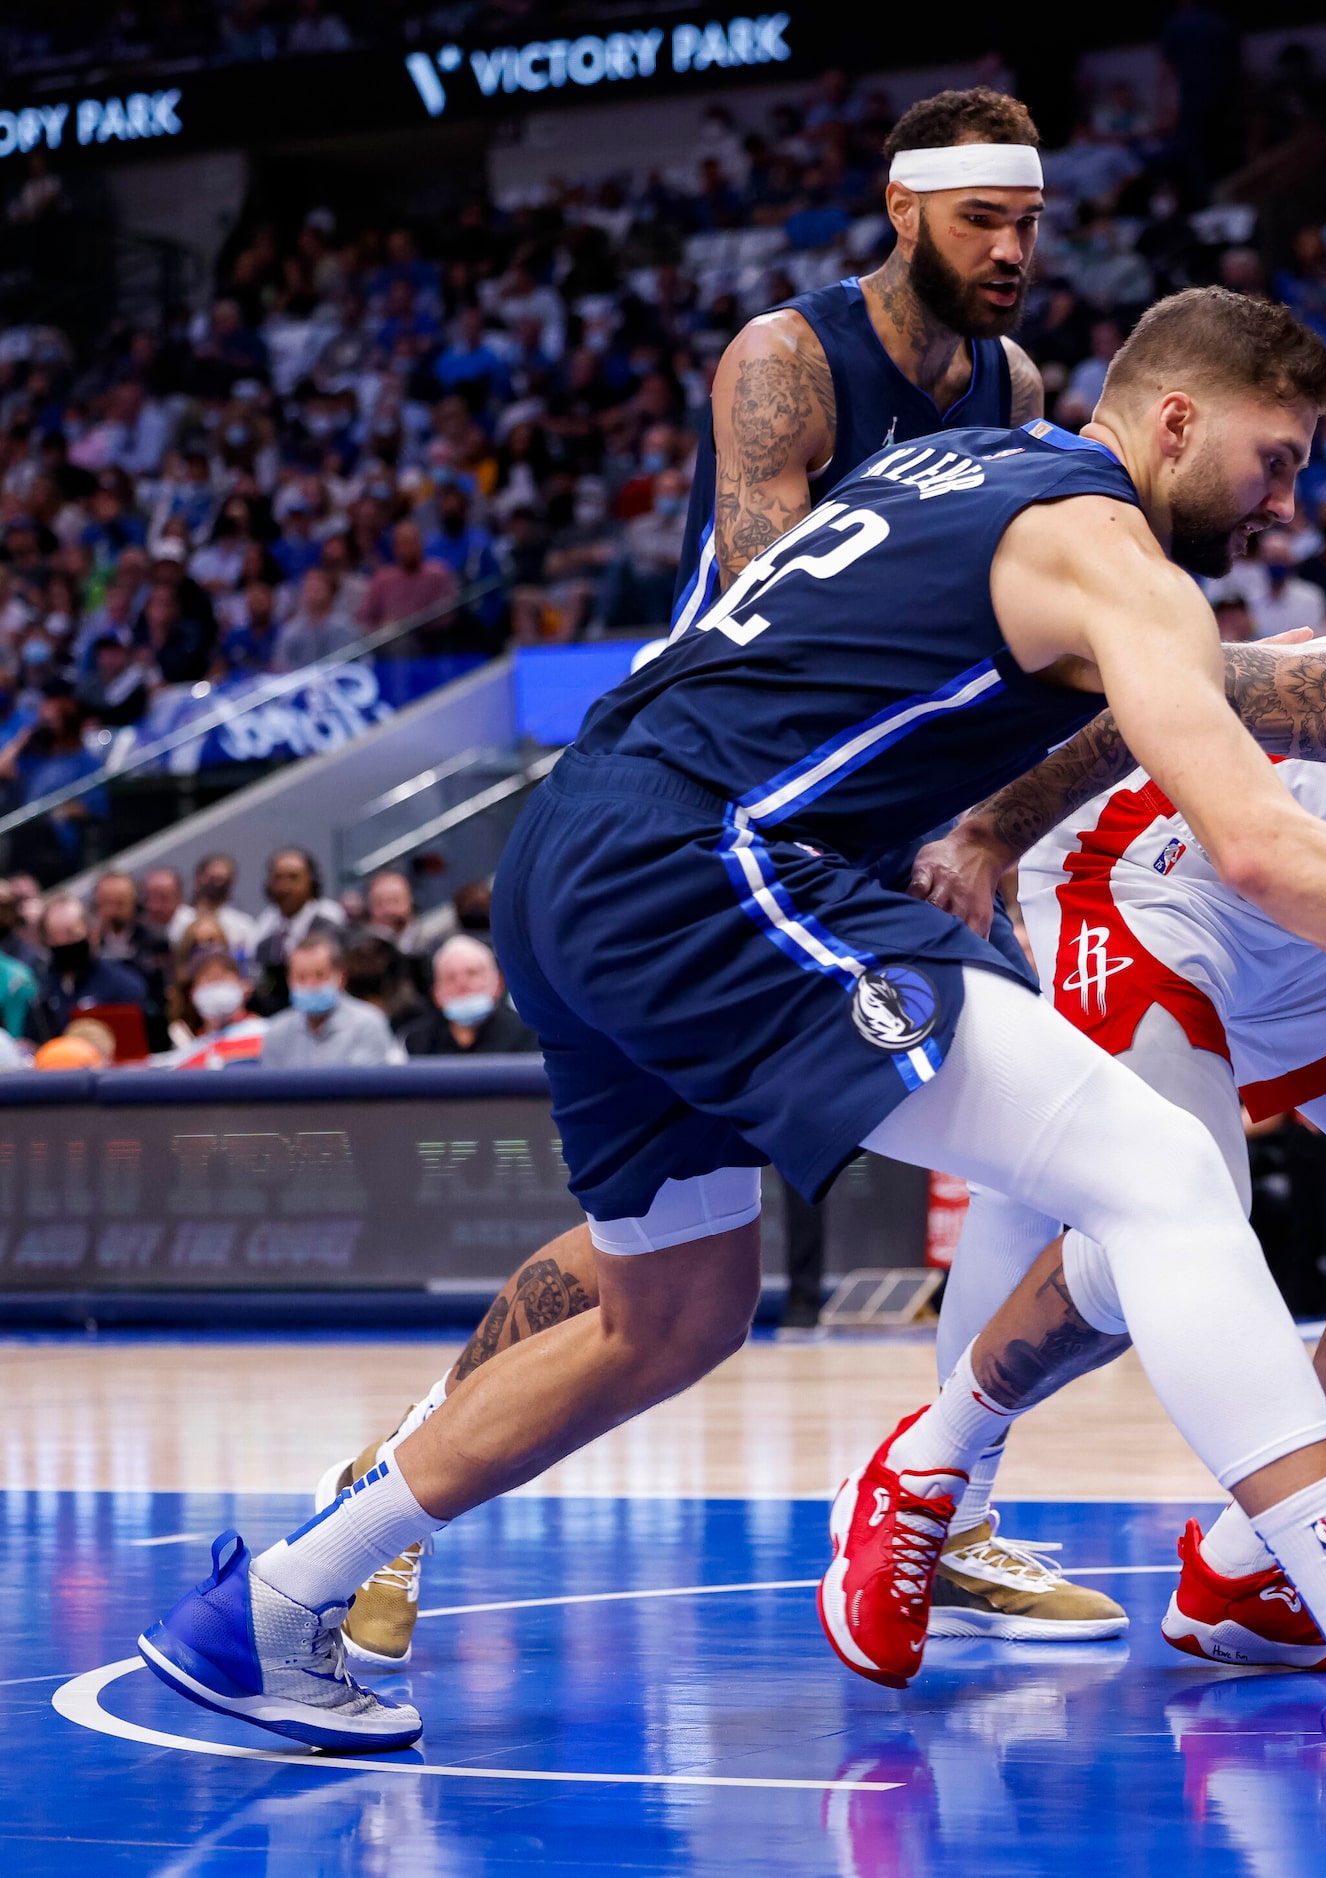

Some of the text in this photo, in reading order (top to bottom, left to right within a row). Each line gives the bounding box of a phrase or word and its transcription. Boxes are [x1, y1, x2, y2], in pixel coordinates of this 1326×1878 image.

[470, 12, 790, 96] VICTORY PARK
[77, 88, 183, 146] PARK
